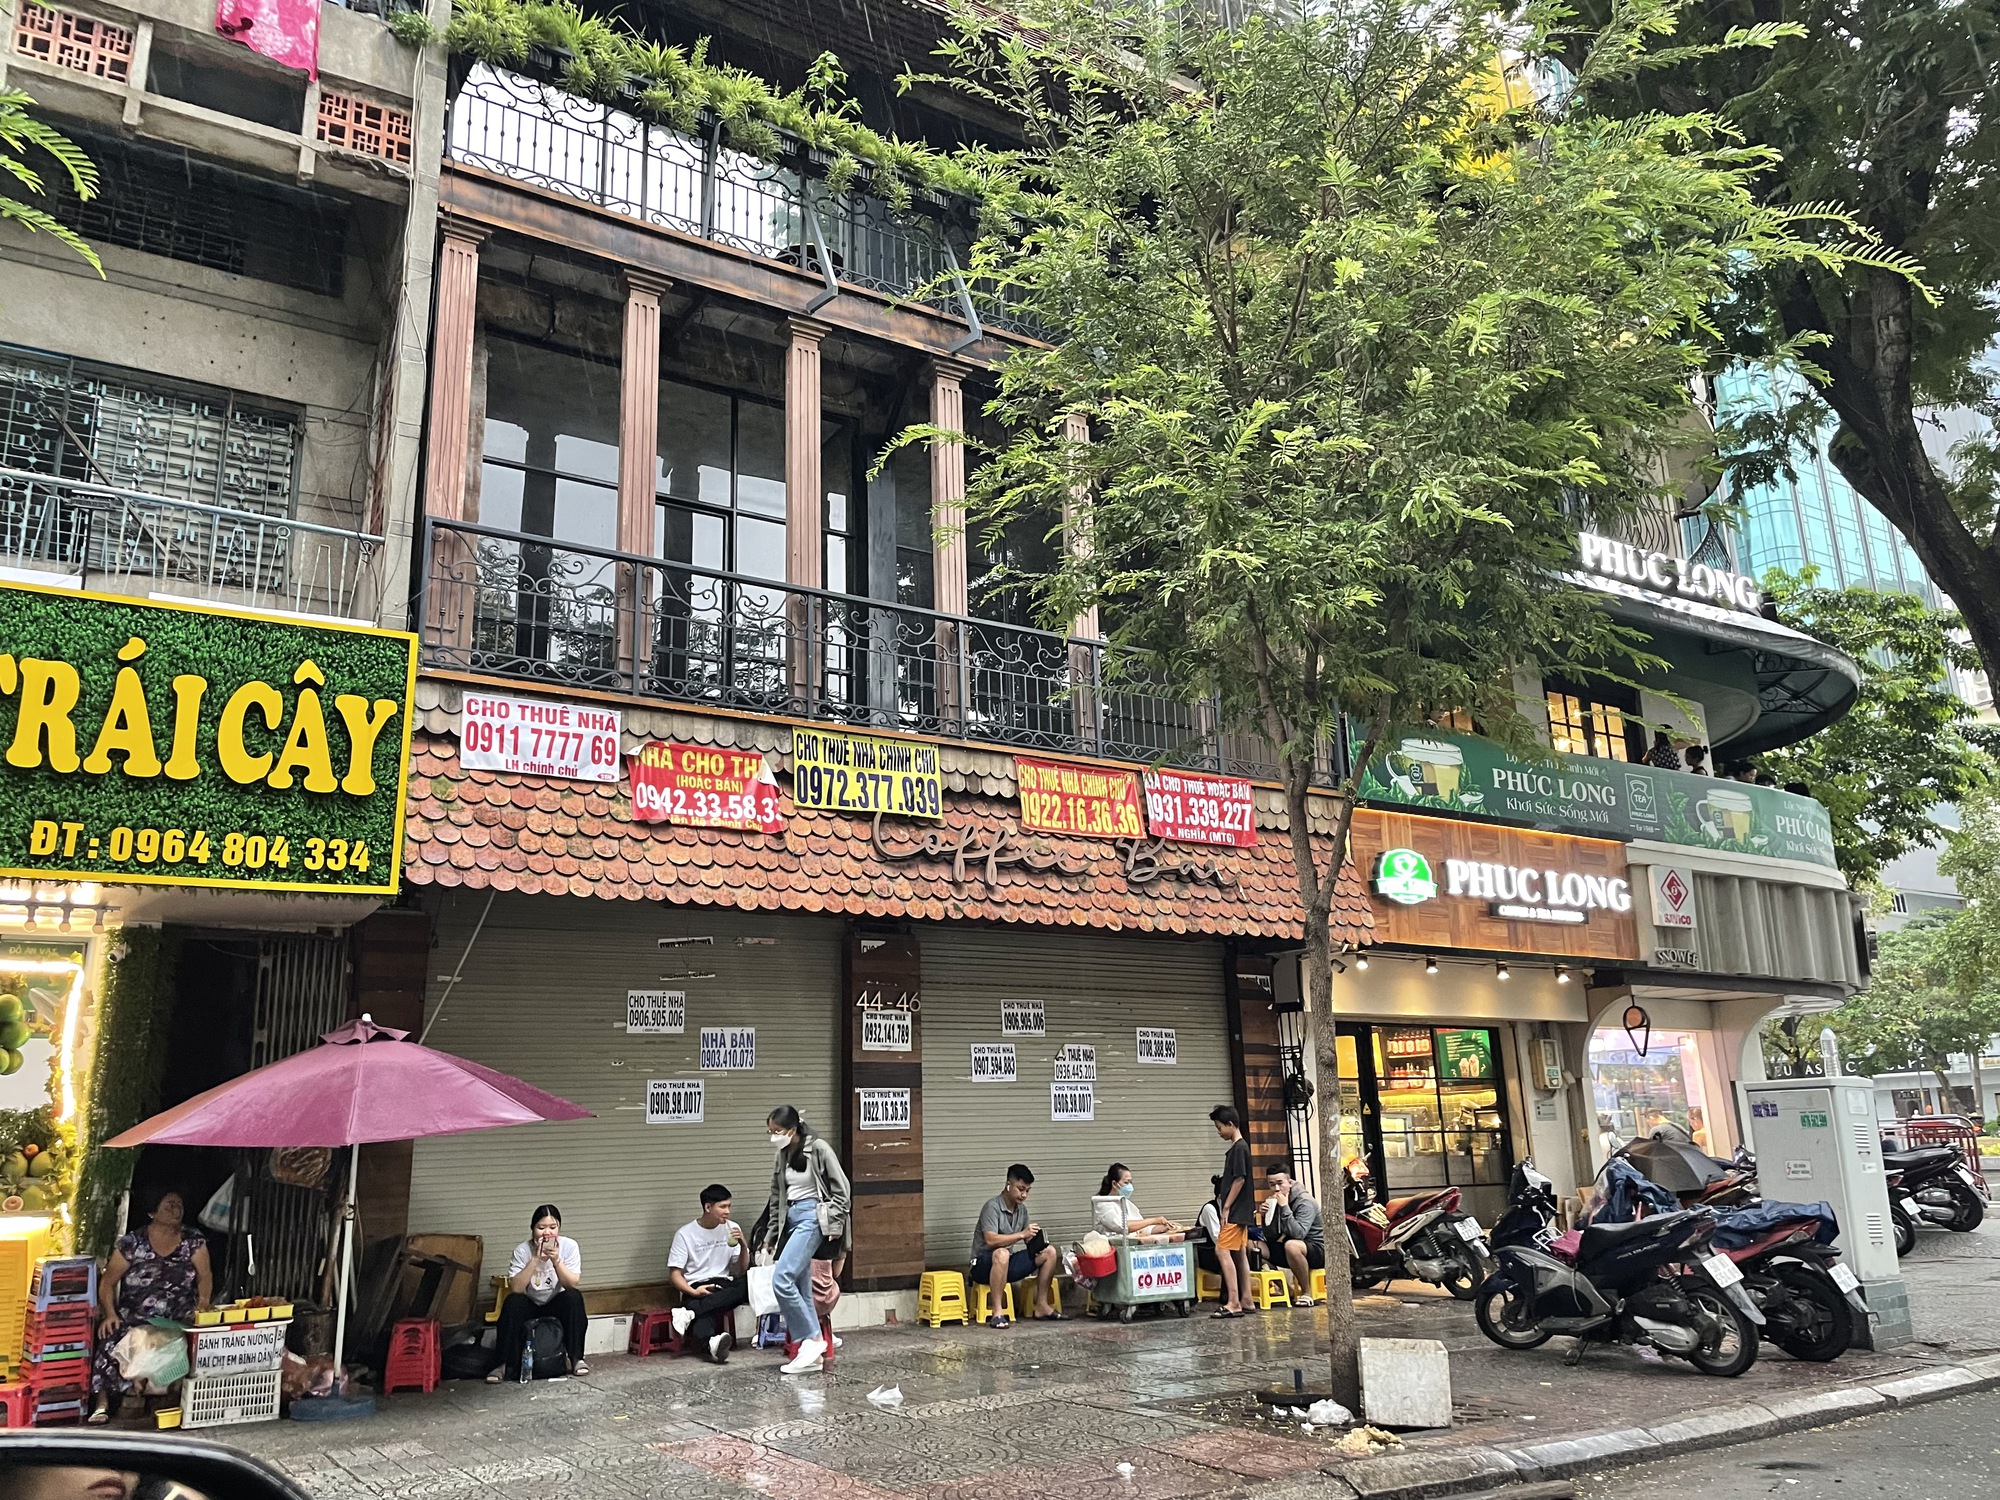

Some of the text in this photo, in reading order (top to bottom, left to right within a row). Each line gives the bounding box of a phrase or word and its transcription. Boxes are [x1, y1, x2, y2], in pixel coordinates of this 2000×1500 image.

[1675, 558, 1762, 610] LONG
[0, 637, 398, 795] RÁI CÂY
[466, 697, 617, 733] CHO THUÊ NHÀ
[465, 720, 617, 767] 0911 7777 69
[796, 733, 819, 761] CHO
[822, 734, 850, 766] THUÊ
[853, 738, 876, 769] NHÀ
[879, 741, 912, 773] CHÍNH
[505, 759, 578, 777] LH chính chủ
[681, 750, 725, 776] CHO
[730, 755, 759, 779] TH
[715, 777, 743, 794] BÁN)
[796, 764, 940, 816] 0972.377.039
[1019, 764, 1037, 789] CHO
[1038, 764, 1060, 792] THUÊ
[1060, 767, 1080, 795] NHÀ
[1080, 770, 1108, 799] CHÍNH
[1162, 775, 1182, 792] CHO
[1183, 777, 1206, 796] THUÊ
[1207, 780, 1231, 801] HOẶC
[1232, 780, 1251, 801] BÁN
[1491, 768, 1617, 807] PHÚC LONG
[1506, 797, 1610, 824] Khơi Sức Sống Mới
[1633, 794, 1647, 804] TEA
[1020, 790, 1140, 836] 0922.16.36.36
[1145, 793, 1252, 832] 0931.339.227
[1166, 827, 1176, 837] A.
[1209, 832, 1235, 845] (MTG)
[1775, 814, 1816, 839] PHÚC
[109, 827, 211, 864] 0964
[222, 833, 290, 869] 804
[304, 838, 370, 872] 334
[1444, 859, 1631, 912] PHUC LONG
[628, 991, 684, 1009] CHO THUÊ NHÀ
[629, 1009, 683, 1027] 0906.905.006
[701, 1029, 754, 1049] NHÀ BÁN
[864, 1022, 909, 1044] 0932.141.789
[701, 1049, 754, 1068] 0903.410.073
[974, 1046, 985, 1054] CHO
[1055, 1064, 1095, 1079] 0936.445.201
[650, 1091, 702, 1115] 0906.98.0017
[863, 1091, 875, 1099] CHO
[863, 1100, 908, 1122] 0922.16.36.36
[198, 1334, 219, 1350] BÁNH
[221, 1333, 246, 1348] TRÁNG
[246, 1330, 274, 1347] NƯỚNG
[212, 1355, 225, 1370] CHỊ
[226, 1354, 237, 1366] EM
[238, 1350, 256, 1364] BÌNH
[257, 1348, 273, 1363] DÂN
